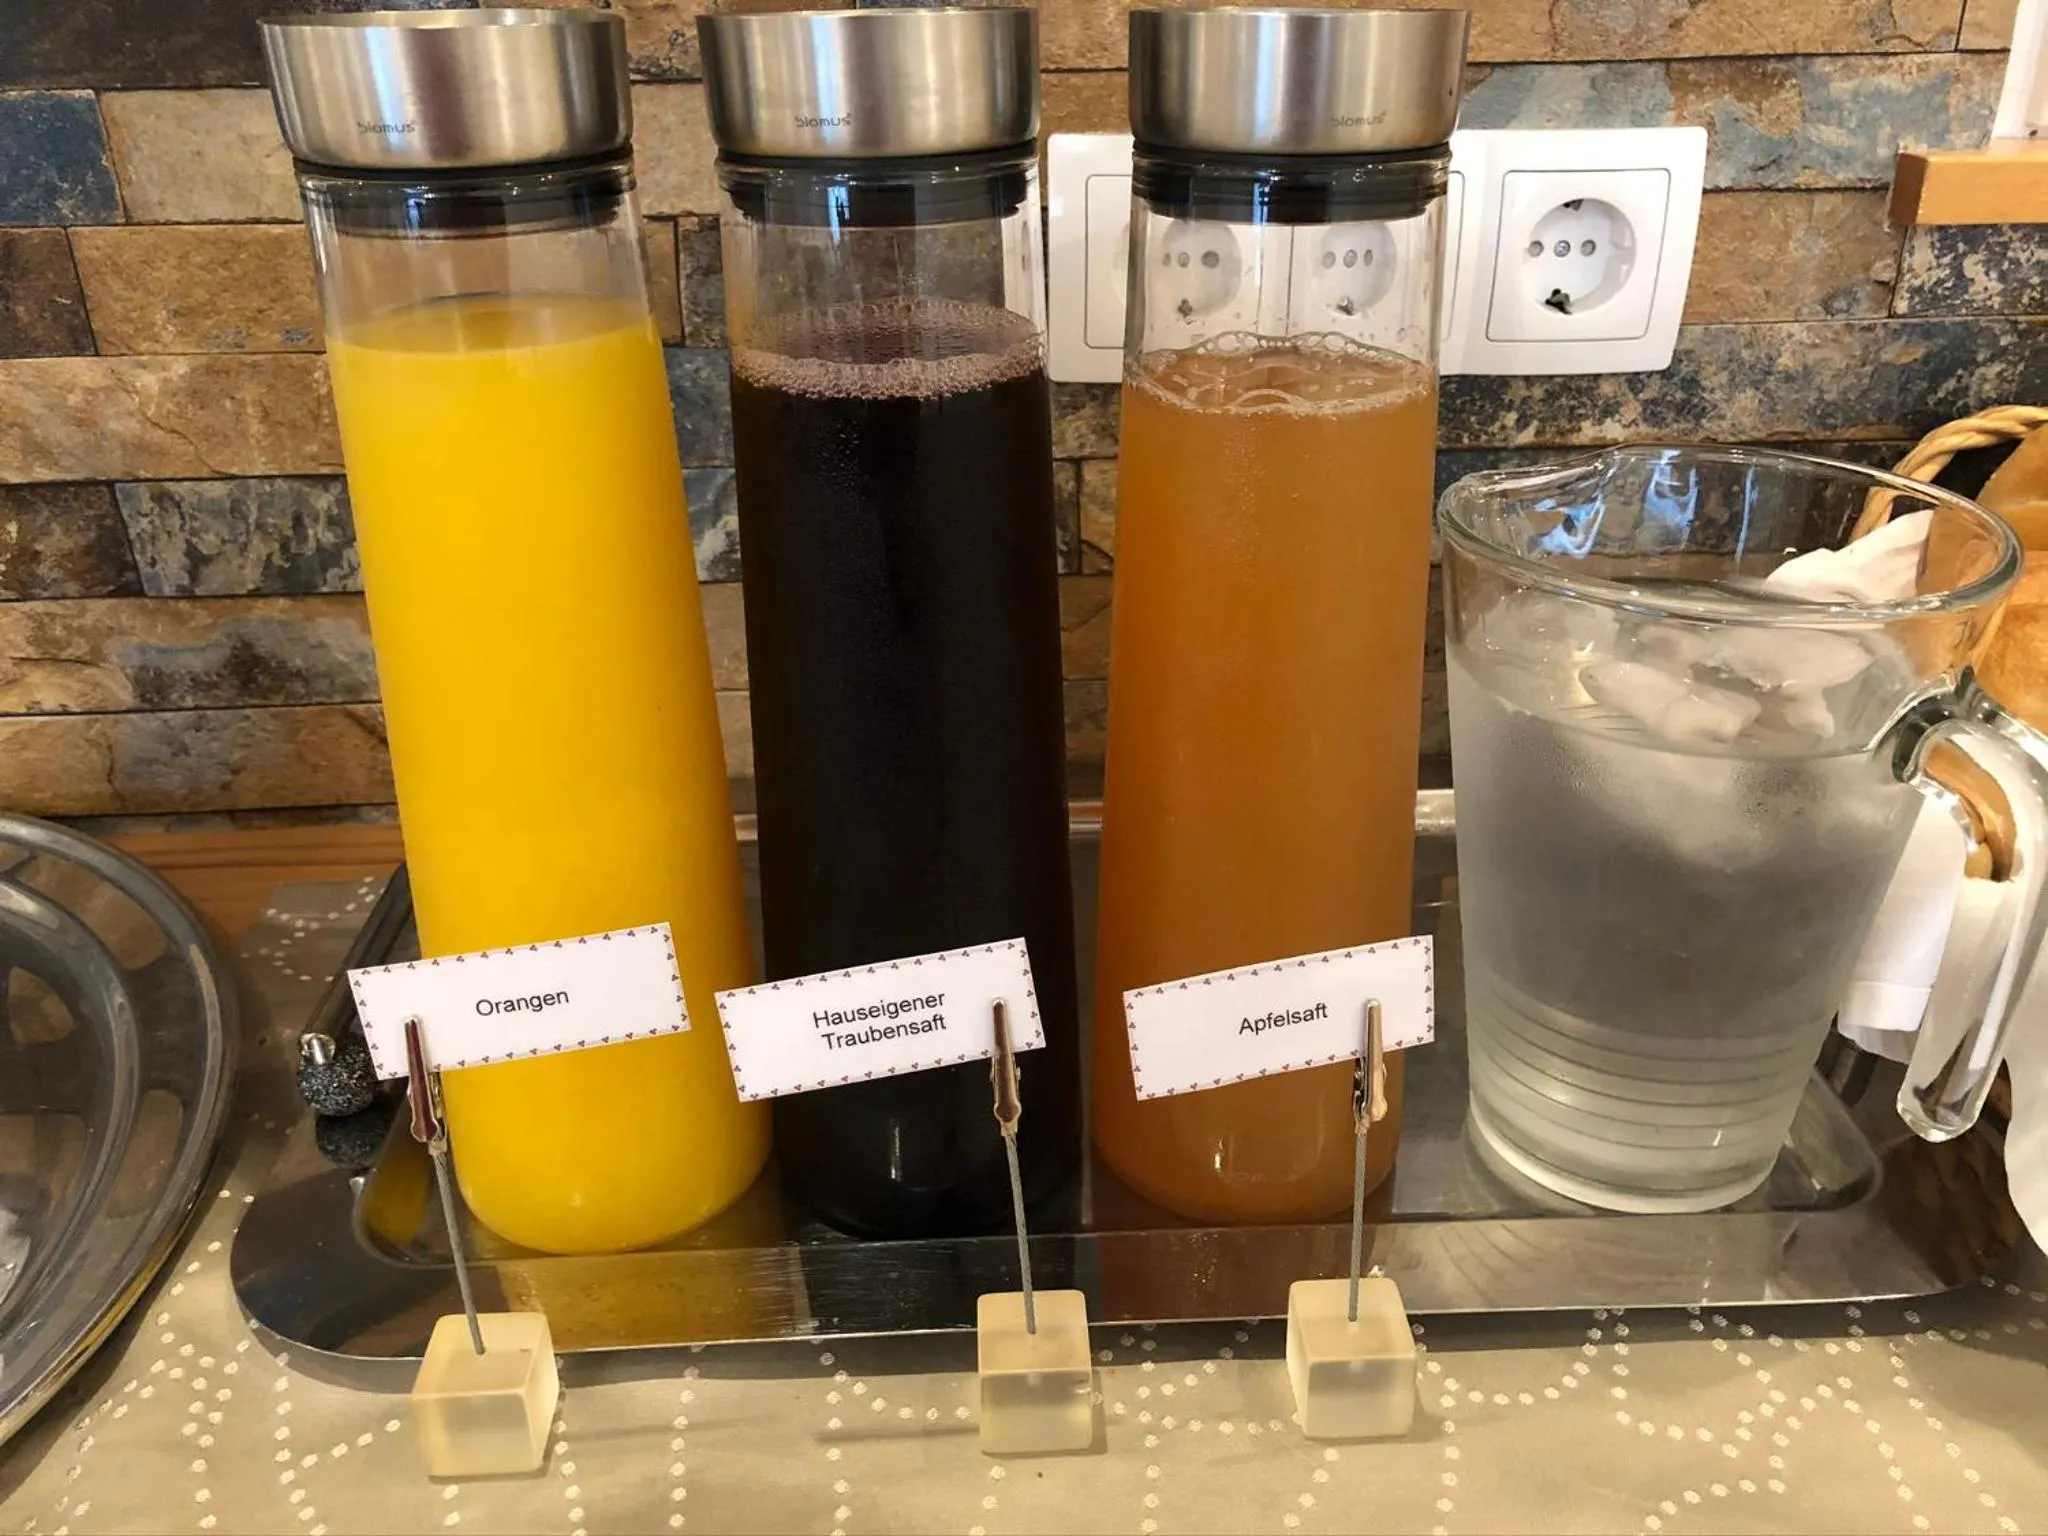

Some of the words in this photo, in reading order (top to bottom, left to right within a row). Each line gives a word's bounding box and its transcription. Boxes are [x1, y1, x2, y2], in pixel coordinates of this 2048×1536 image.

[475, 990, 570, 1017] Orangen
[812, 993, 946, 1029] Hauseigener
[1239, 1002, 1329, 1036] Apfelsaft
[821, 1013, 947, 1051] Traubensaft
